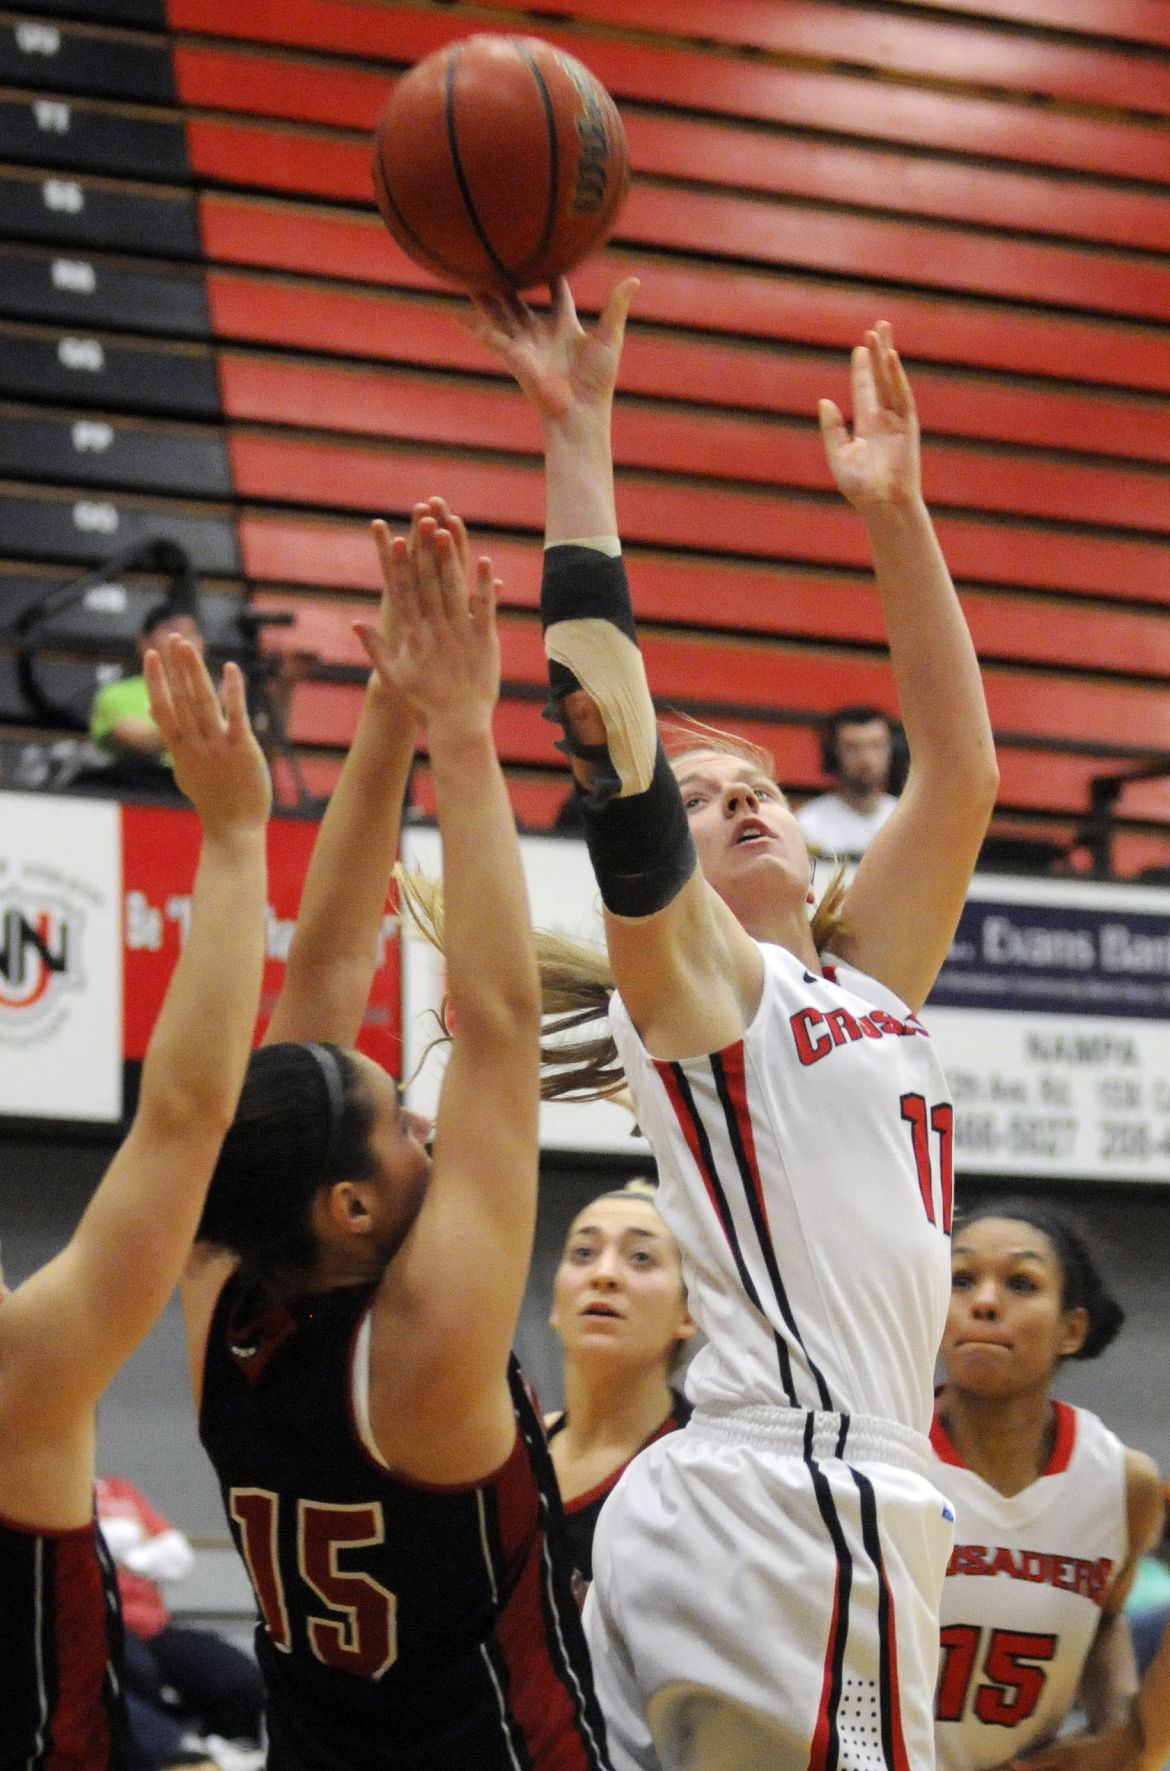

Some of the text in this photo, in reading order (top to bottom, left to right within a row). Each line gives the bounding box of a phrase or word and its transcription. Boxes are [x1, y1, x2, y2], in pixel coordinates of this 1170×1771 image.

[900, 1092, 953, 1238] 11
[230, 1487, 398, 1681] 15
[936, 1624, 1058, 1728] 15
